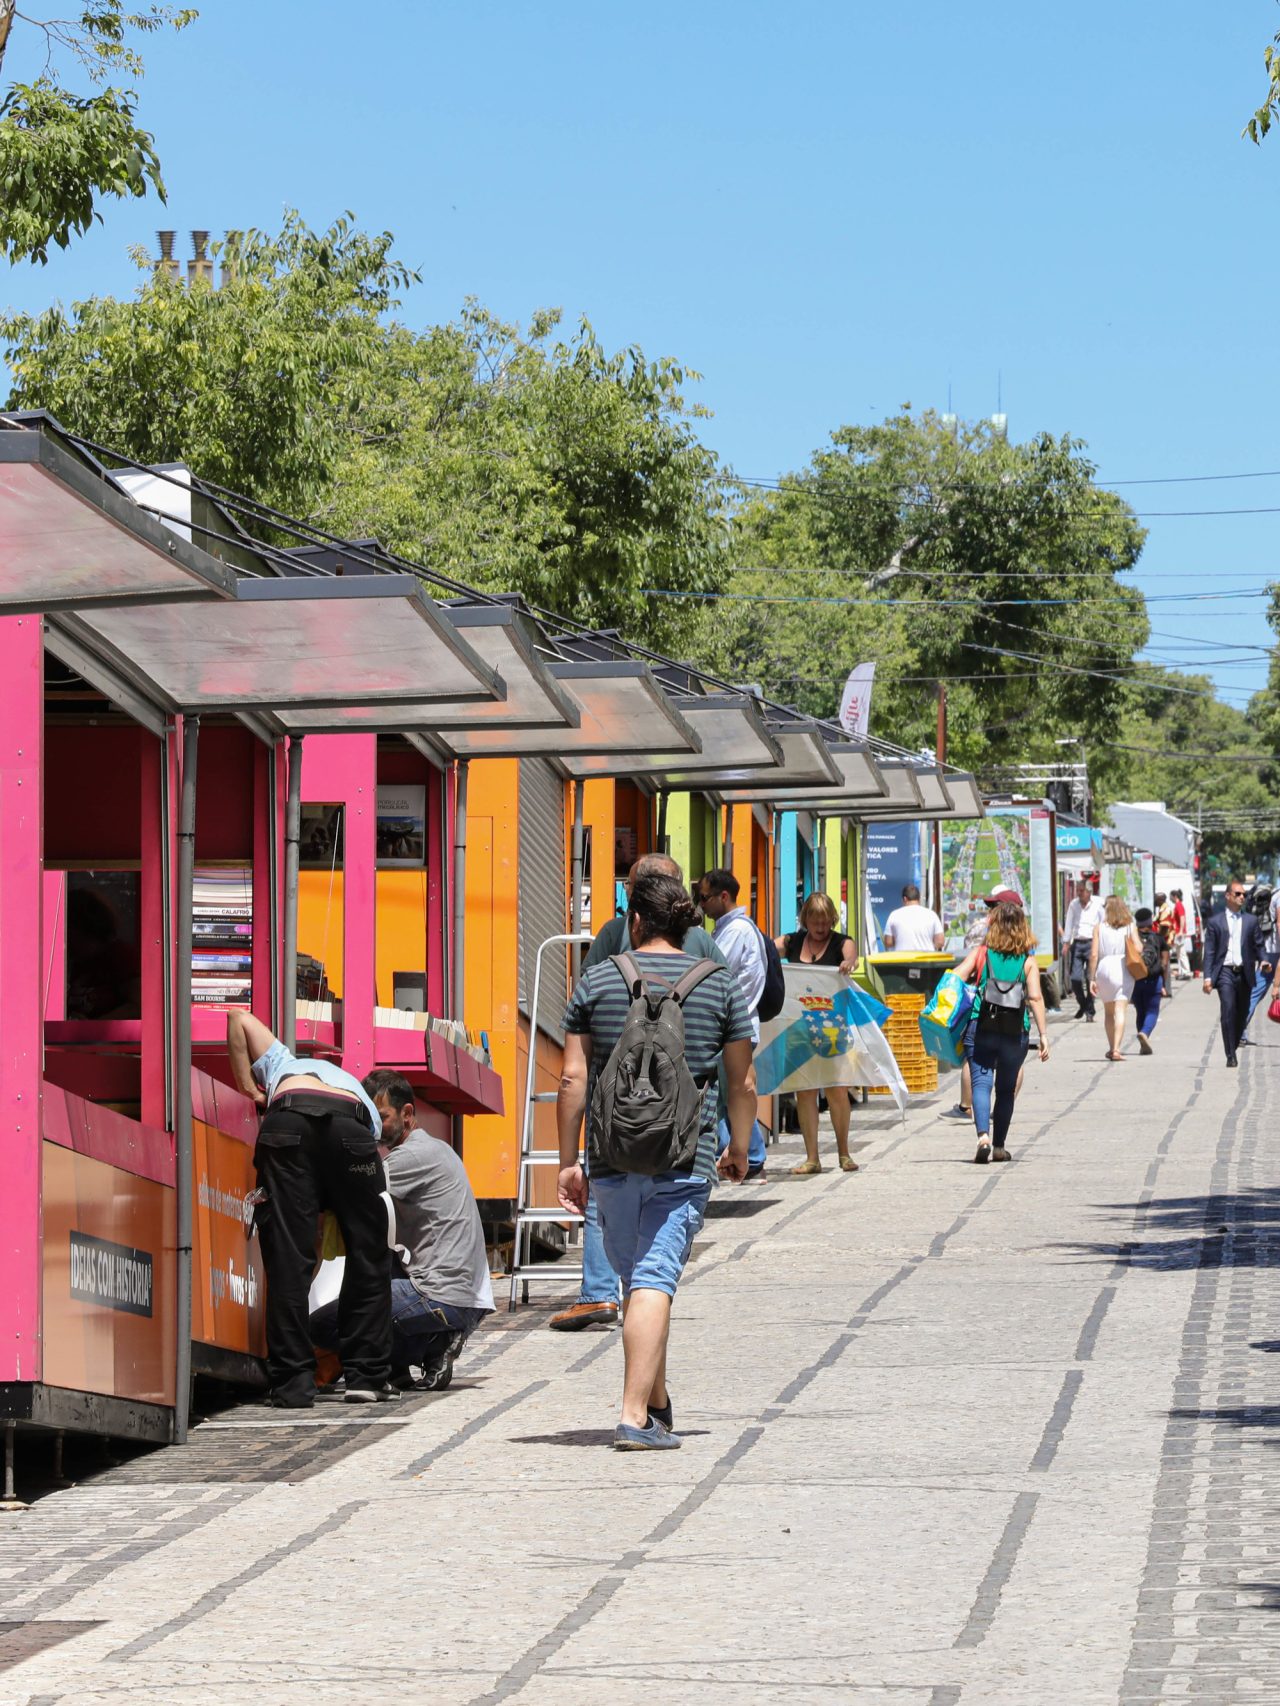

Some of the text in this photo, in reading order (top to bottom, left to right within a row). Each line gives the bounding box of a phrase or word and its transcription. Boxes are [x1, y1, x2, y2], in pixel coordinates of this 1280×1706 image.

[70, 1243, 96, 1294] IDEIAS
[97, 1250, 115, 1298] COM
[229, 1257, 244, 1305] livros
